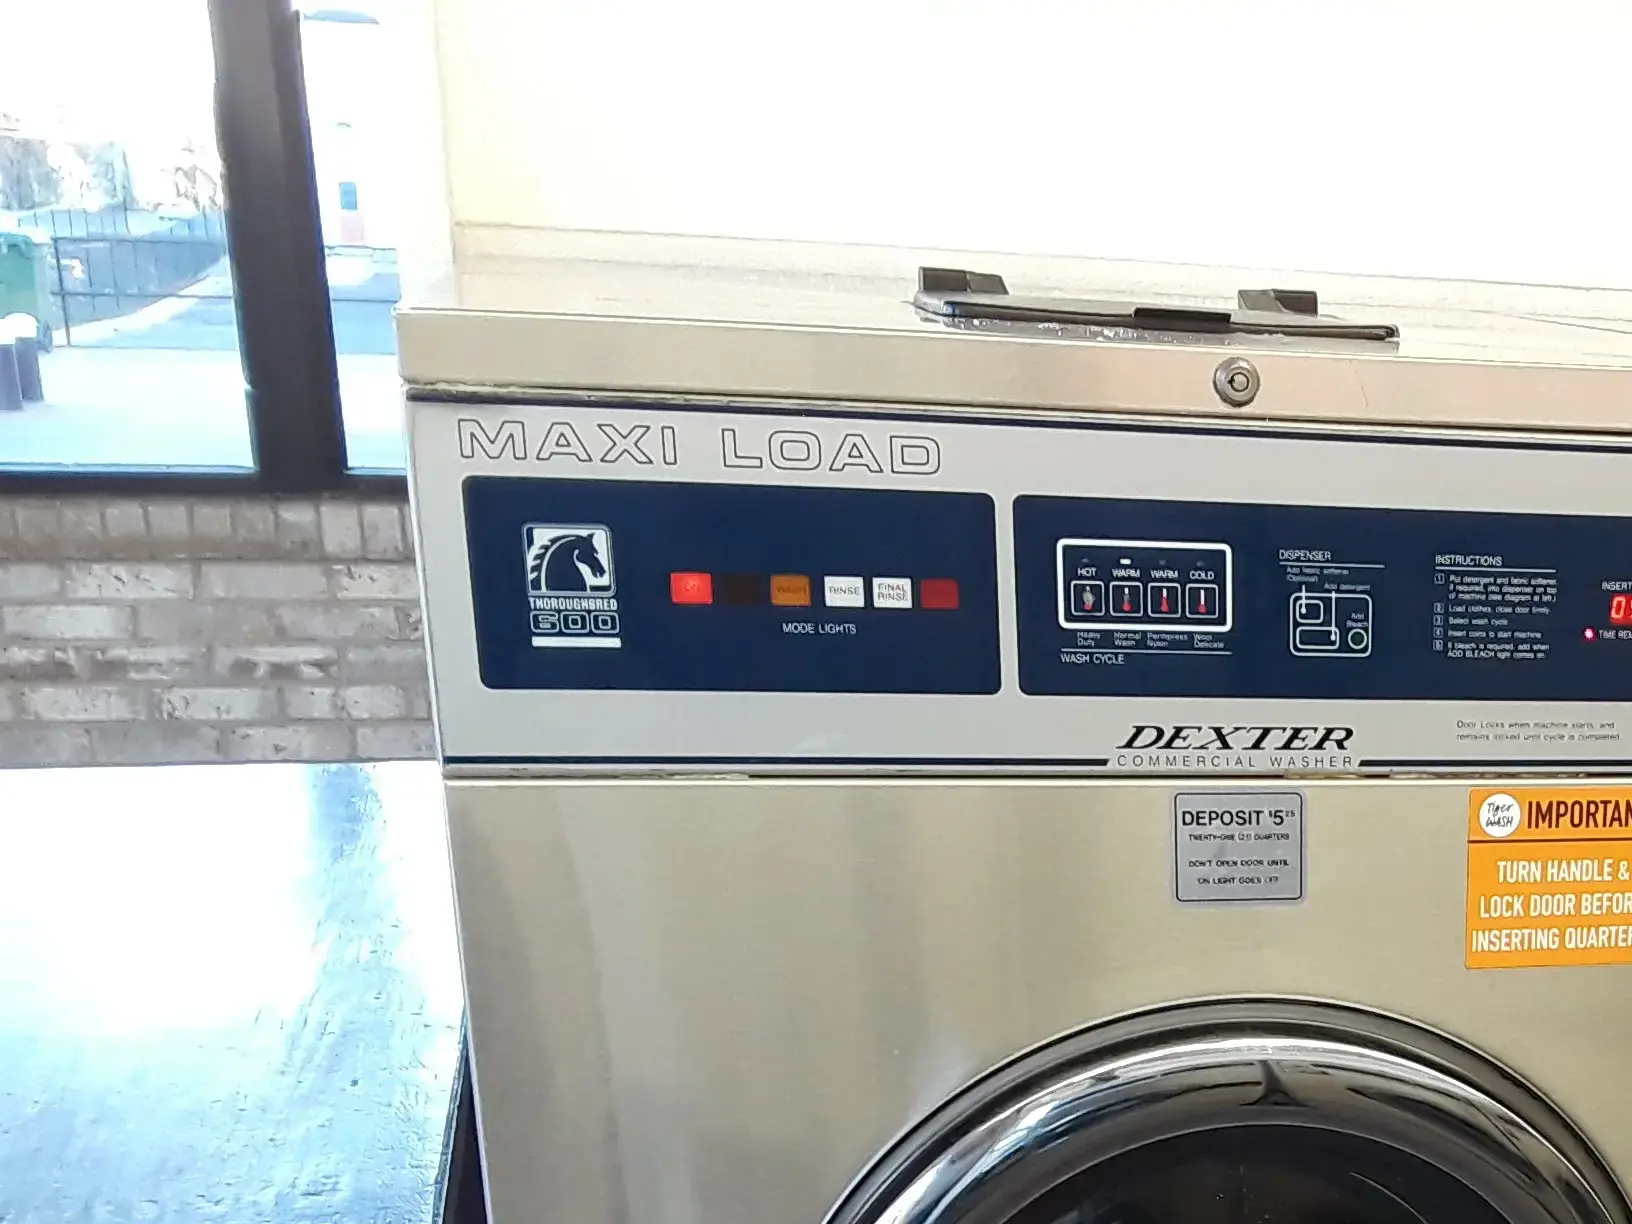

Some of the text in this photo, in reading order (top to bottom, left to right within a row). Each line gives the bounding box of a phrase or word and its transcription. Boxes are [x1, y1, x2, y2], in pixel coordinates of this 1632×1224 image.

[457, 419, 941, 475] MAXI LOAD
[1279, 549, 1332, 561] DISPENSER
[1435, 555, 1502, 566] INSTRUCTIONS
[1077, 567, 1097, 577] HOT
[1112, 568, 1141, 578] WARM
[1150, 569, 1179, 579] WARM
[1189, 571, 1215, 580] COLD
[829, 585, 861, 596] RINSE
[878, 582, 907, 592] FINAL
[1602, 581, 1632, 591] INSERT
[878, 591, 909, 602] RINSE
[528, 597, 618, 611] THOROUGHBRED
[1449, 604, 1465, 612] Load
[529, 611, 621, 633] 600
[782, 622, 857, 635] MODE LIGHTS
[1599, 629, 1616, 639] TIME
[1060, 653, 1126, 665] WASH CYCLE
[1456, 719, 1477, 729] Door
[1508, 721, 1531, 729] when
[1600, 721, 1615, 729] and
[1116, 725, 1354, 750] DEXTER
[1117, 754, 1352, 768] COMMERCIAL WASHER
[1487, 800, 1514, 818] Tiger
[1181, 809, 1265, 826] DEPOSIT
[1485, 815, 1514, 829] WASH
[1254, 832, 1290, 841] QUARTERS
[1215, 859, 1238, 868] OPEN
[1240, 859, 1265, 867] DOOR
[1267, 858, 1290, 867] UNTIL
[1496, 858, 1631, 884] TURN HANDLE &
[1213, 876, 1237, 885] LIGHT
[1238, 876, 1262, 885] GOES
[1479, 894, 1525, 919] LOCK
[1529, 893, 1576, 918] DOOR
[1471, 927, 1560, 953] INSERTING
